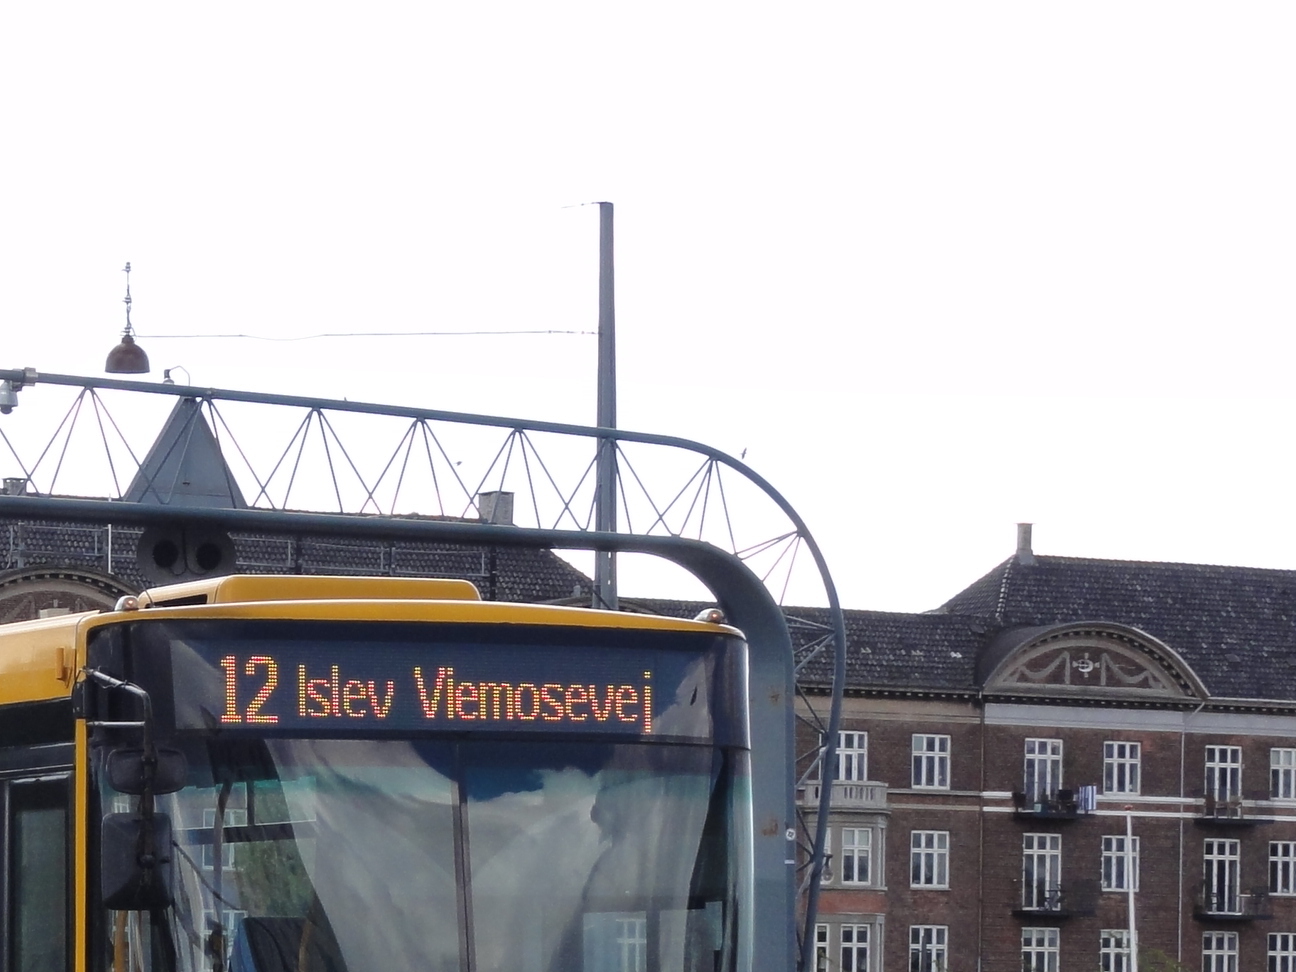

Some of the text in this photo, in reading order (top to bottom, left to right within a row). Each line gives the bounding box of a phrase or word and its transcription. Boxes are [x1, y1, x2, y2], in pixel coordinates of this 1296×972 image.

[220, 655, 652, 733] 12 Islev Viemosevej
